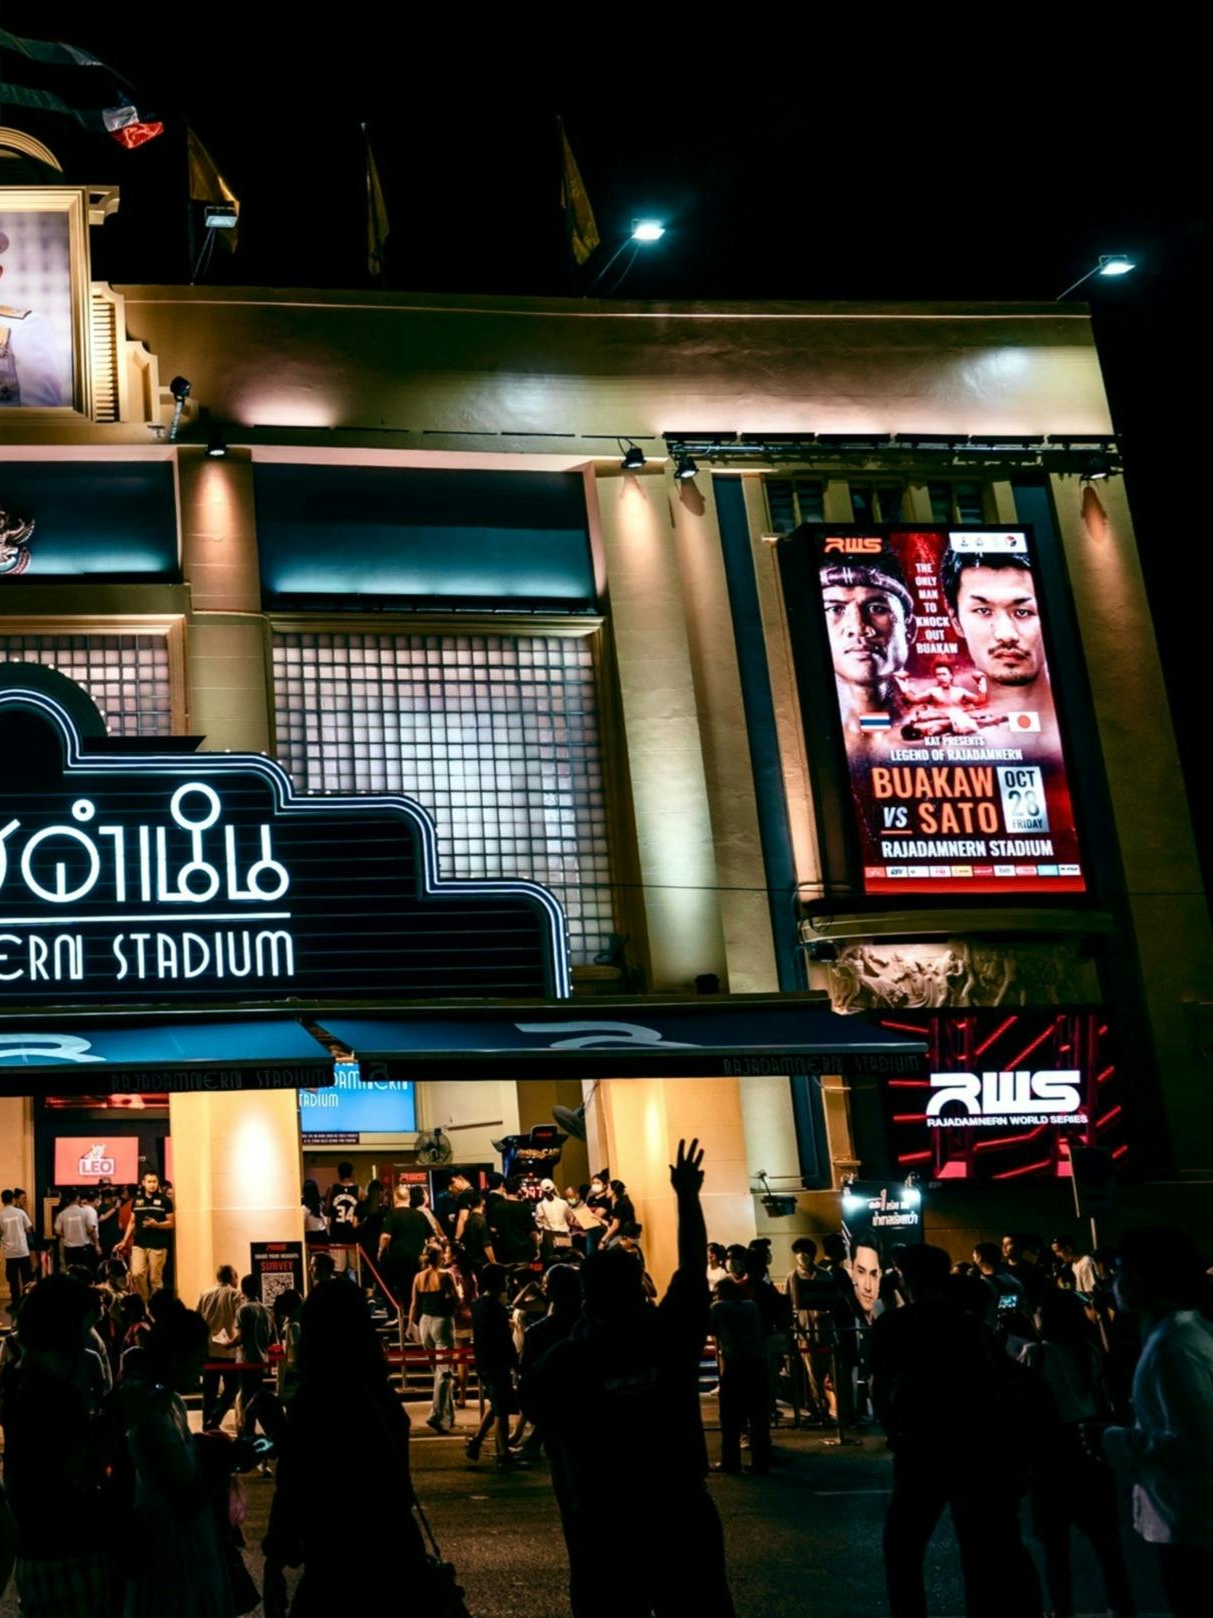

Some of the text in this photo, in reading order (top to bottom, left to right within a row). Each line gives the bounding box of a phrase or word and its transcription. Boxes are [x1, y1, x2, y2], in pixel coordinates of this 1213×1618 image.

[824, 537, 882, 553] RWS
[915, 563, 933, 573] THE
[915, 576, 936, 586] ONLY
[918, 590, 938, 599] MAN
[924, 602, 937, 612] TO
[916, 616, 950, 626] KNOCK
[925, 630, 944, 640] OUT
[916, 643, 958, 654] BUAKAW
[942, 736, 986, 746] PRESENTS
[891, 748, 1022, 761] LEGEND OF RAJADAMNERN
[872, 767, 993, 798] BUAKAW
[1004, 770, 1036, 788] OCT
[1008, 790, 1040, 817] 28
[884, 802, 998, 834] VS SATO
[1012, 818, 1043, 829] FRIDAY
[881, 840, 1054, 858] RAJADAMNERN STADIUM
[113, 930, 295, 980] STADIUM
[723, 1055, 920, 1076] RAJADAMNERN STADIUM
[111, 1068, 328, 1092] RAJADAMNERN STADIUM
[926, 1070, 1081, 1116] RWS
[927, 1114, 1088, 1127] RAJADAMNERN WORLD SERIES
[82, 1161, 113, 1174] LEO
[336, 1205, 354, 1224] 34
[260, 1260, 294, 1271] SURVEY
